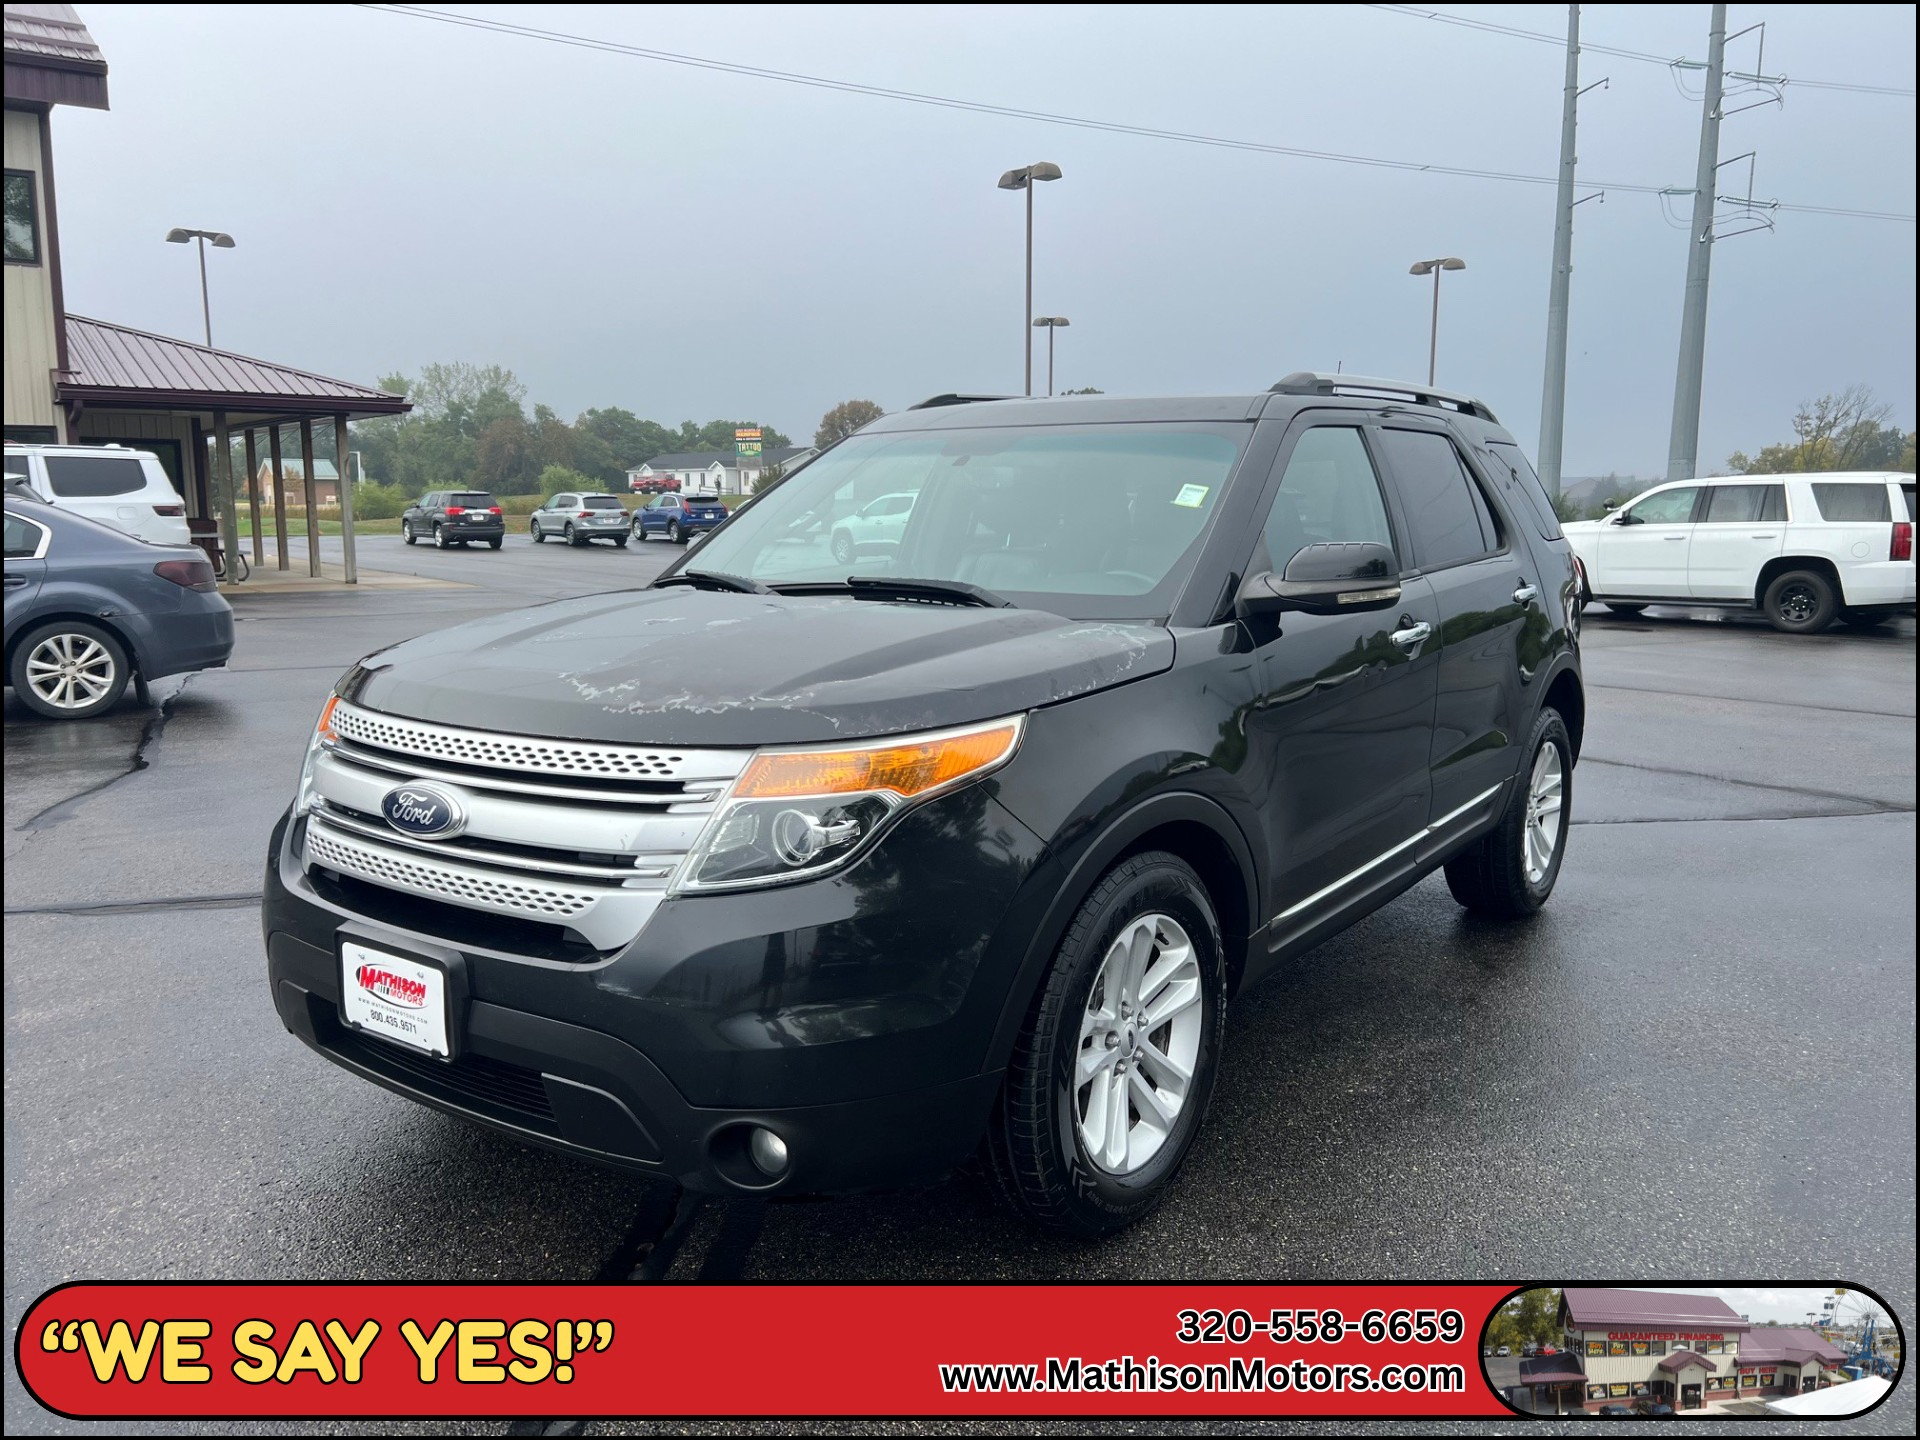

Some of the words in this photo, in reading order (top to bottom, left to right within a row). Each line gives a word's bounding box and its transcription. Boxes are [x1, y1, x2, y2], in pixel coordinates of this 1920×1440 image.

[737, 442, 762, 452] TATTOO
[392, 791, 437, 826] Ford
[359, 965, 427, 999] MATHISON
[390, 988, 424, 1007] MOTORS
[369, 1008, 418, 1035] 800.435.9571
